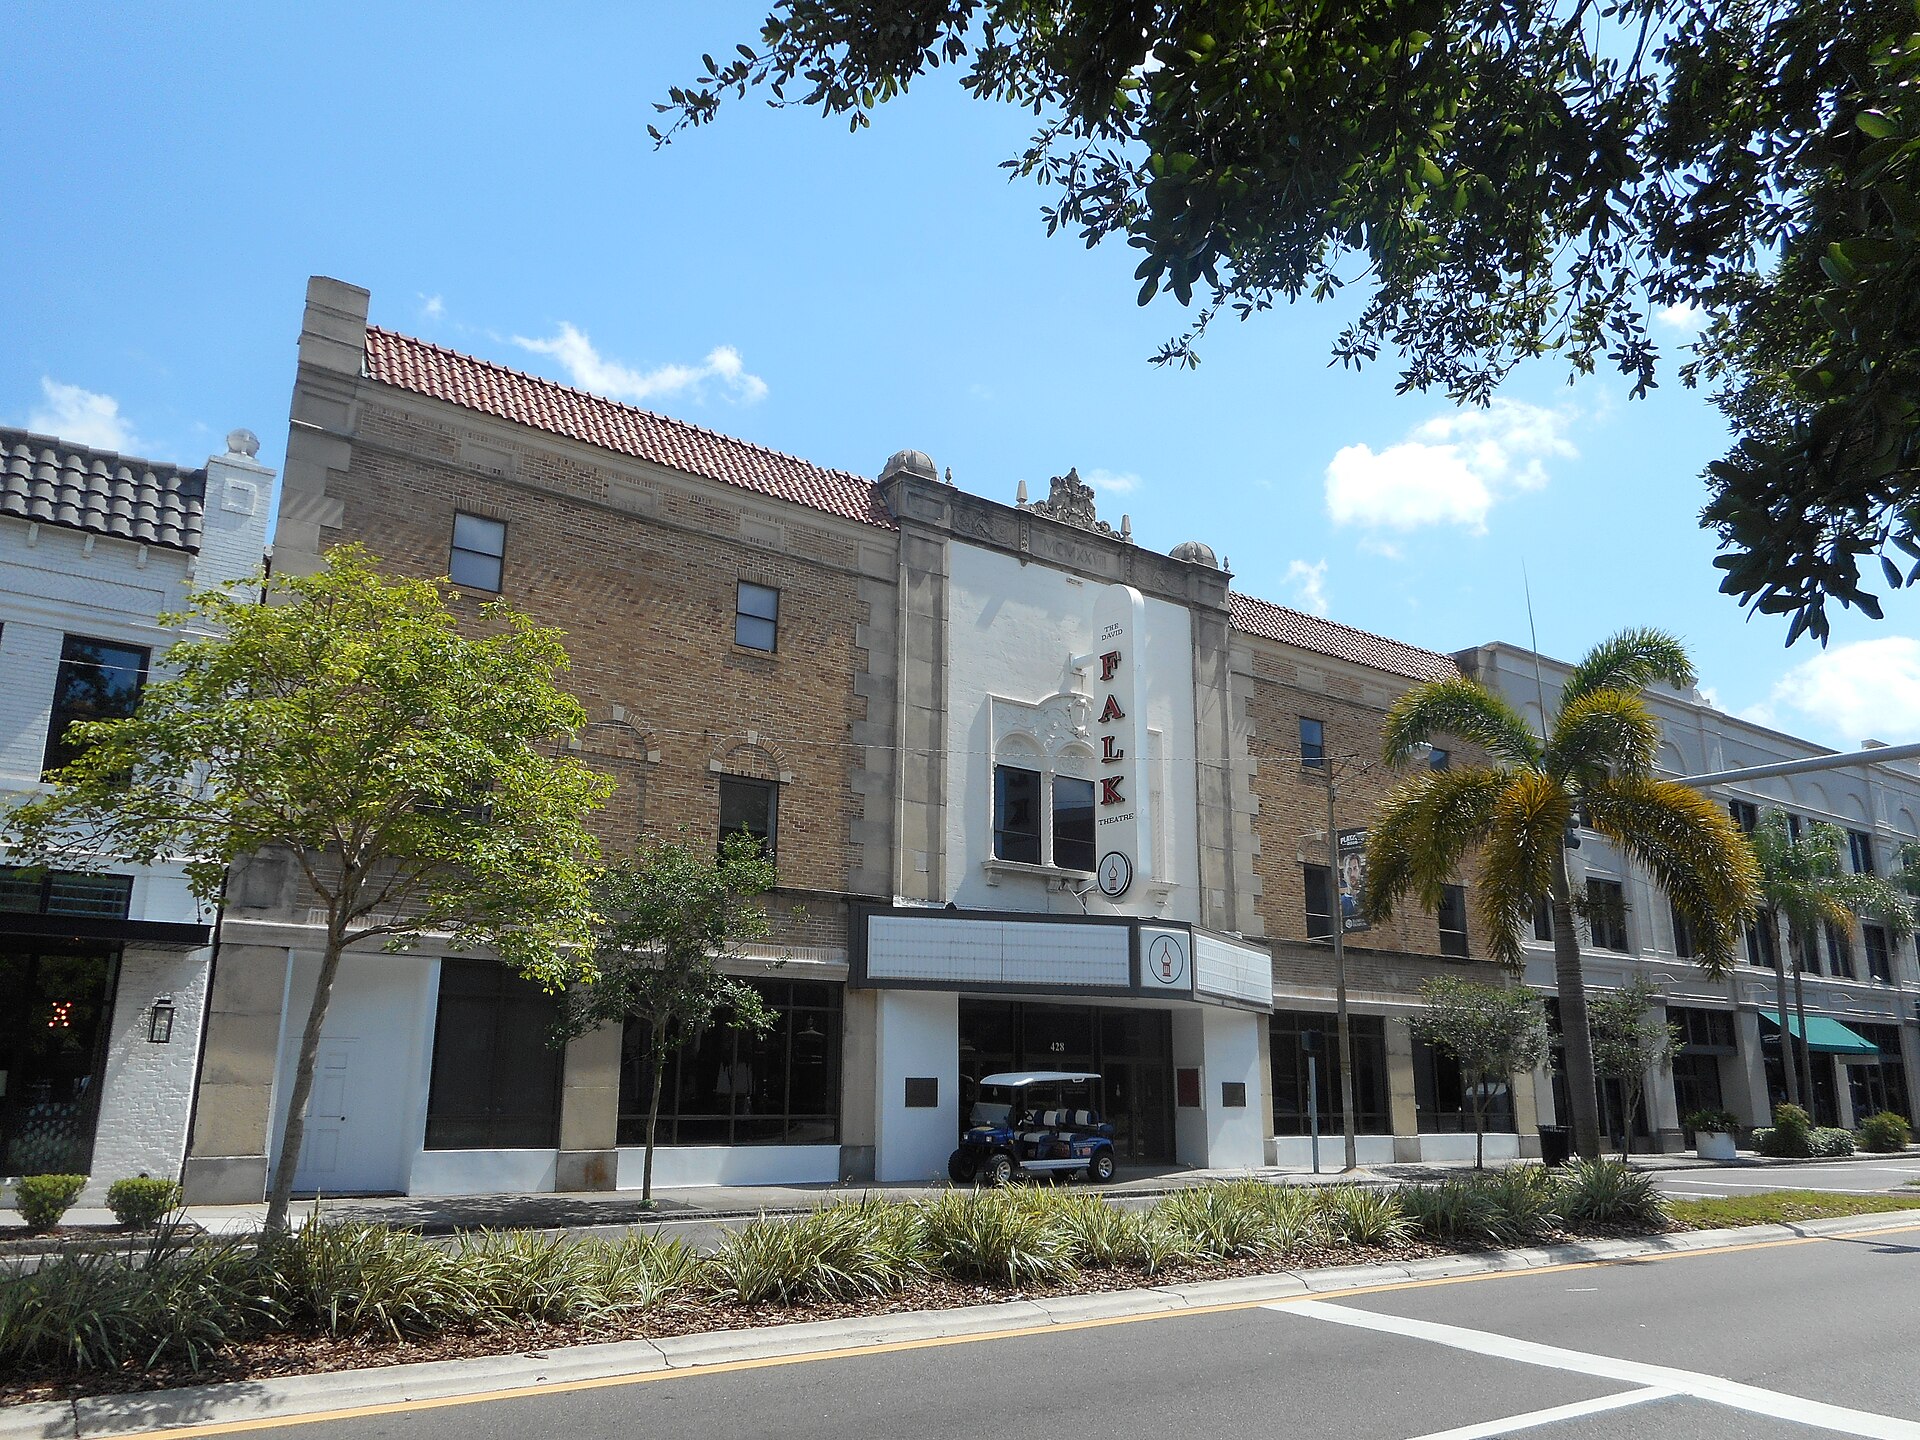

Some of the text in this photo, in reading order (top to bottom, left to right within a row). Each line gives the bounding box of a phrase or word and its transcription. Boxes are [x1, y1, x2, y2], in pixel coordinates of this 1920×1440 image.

[1104, 623, 1118, 632] THE
[1102, 629, 1122, 640] DAVID
[1098, 651, 1125, 805] FALK
[1098, 813, 1134, 825] THEATRE
[1050, 1042, 1065, 1051] 428
